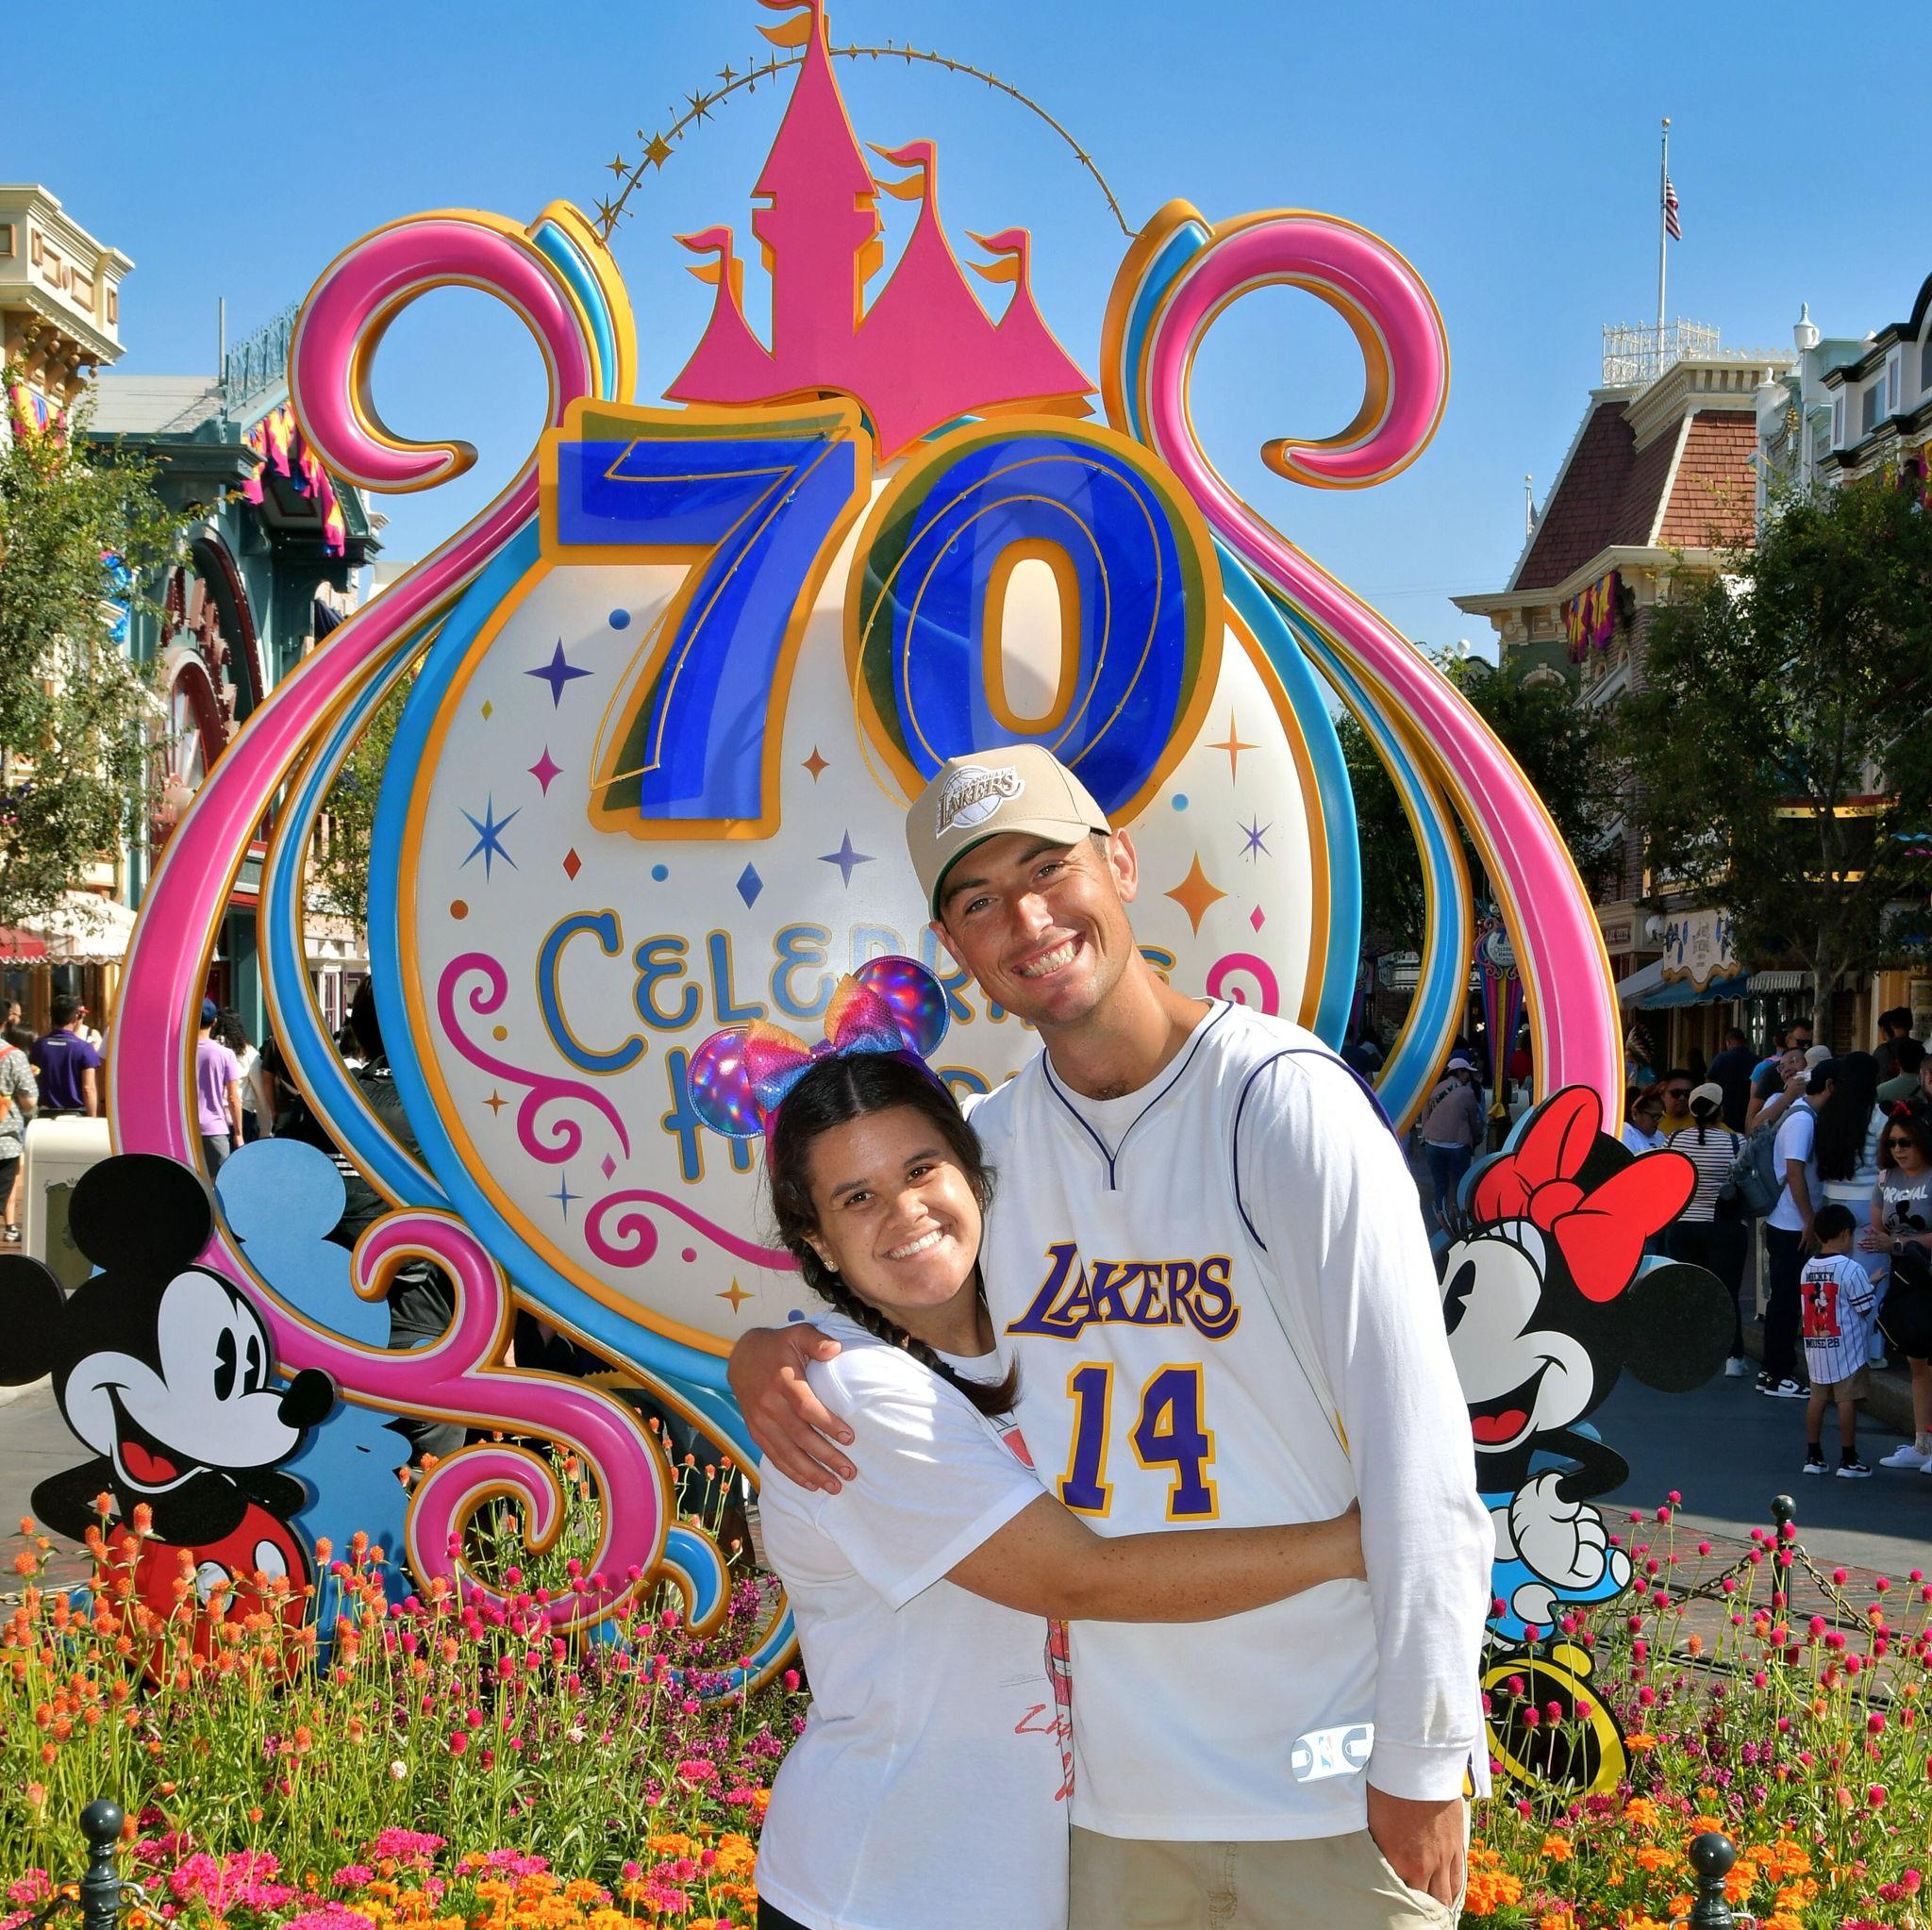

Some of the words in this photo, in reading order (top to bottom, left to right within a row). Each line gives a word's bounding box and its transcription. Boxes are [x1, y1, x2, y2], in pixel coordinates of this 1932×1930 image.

[541, 396, 1224, 840] 70
[937, 774, 1022, 834] LAKERS
[1004, 1240, 1241, 1342] LAKERS
[1806, 1272, 1835, 1282] MICKEY
[1806, 1338, 1827, 1349] MOUSE
[1827, 1338, 1840, 1348] 28
[1057, 1360, 1220, 1522] 14
